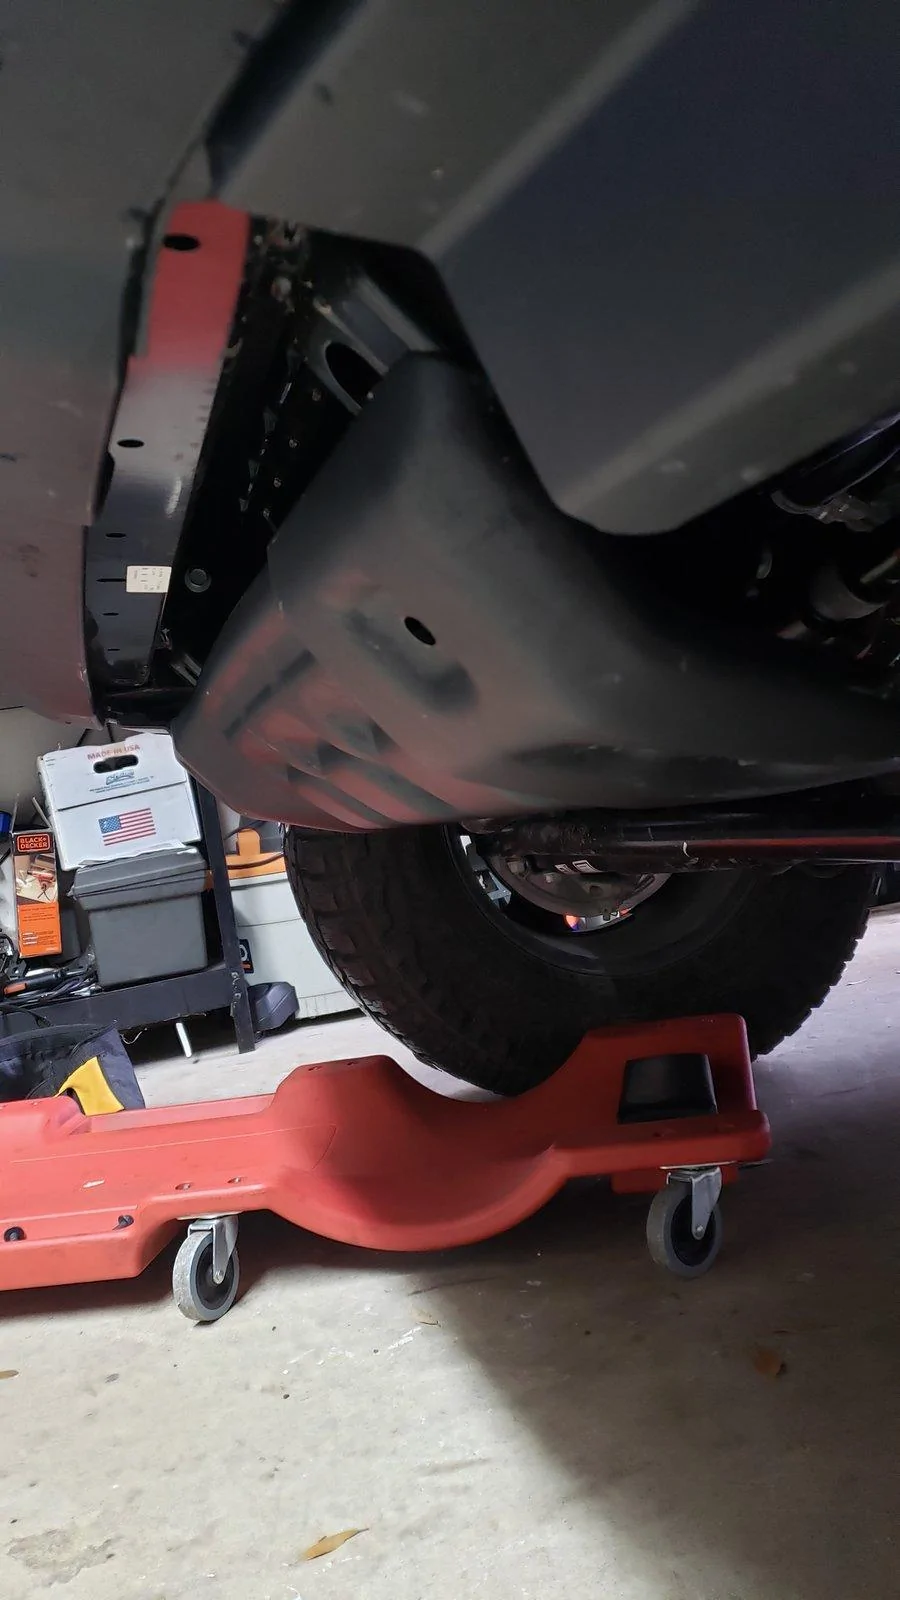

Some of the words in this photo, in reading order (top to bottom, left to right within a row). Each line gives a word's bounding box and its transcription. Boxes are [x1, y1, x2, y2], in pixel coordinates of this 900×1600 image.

[87, 750, 111, 760] MADE
[113, 747, 122, 755] IN
[124, 744, 140, 752] USA
